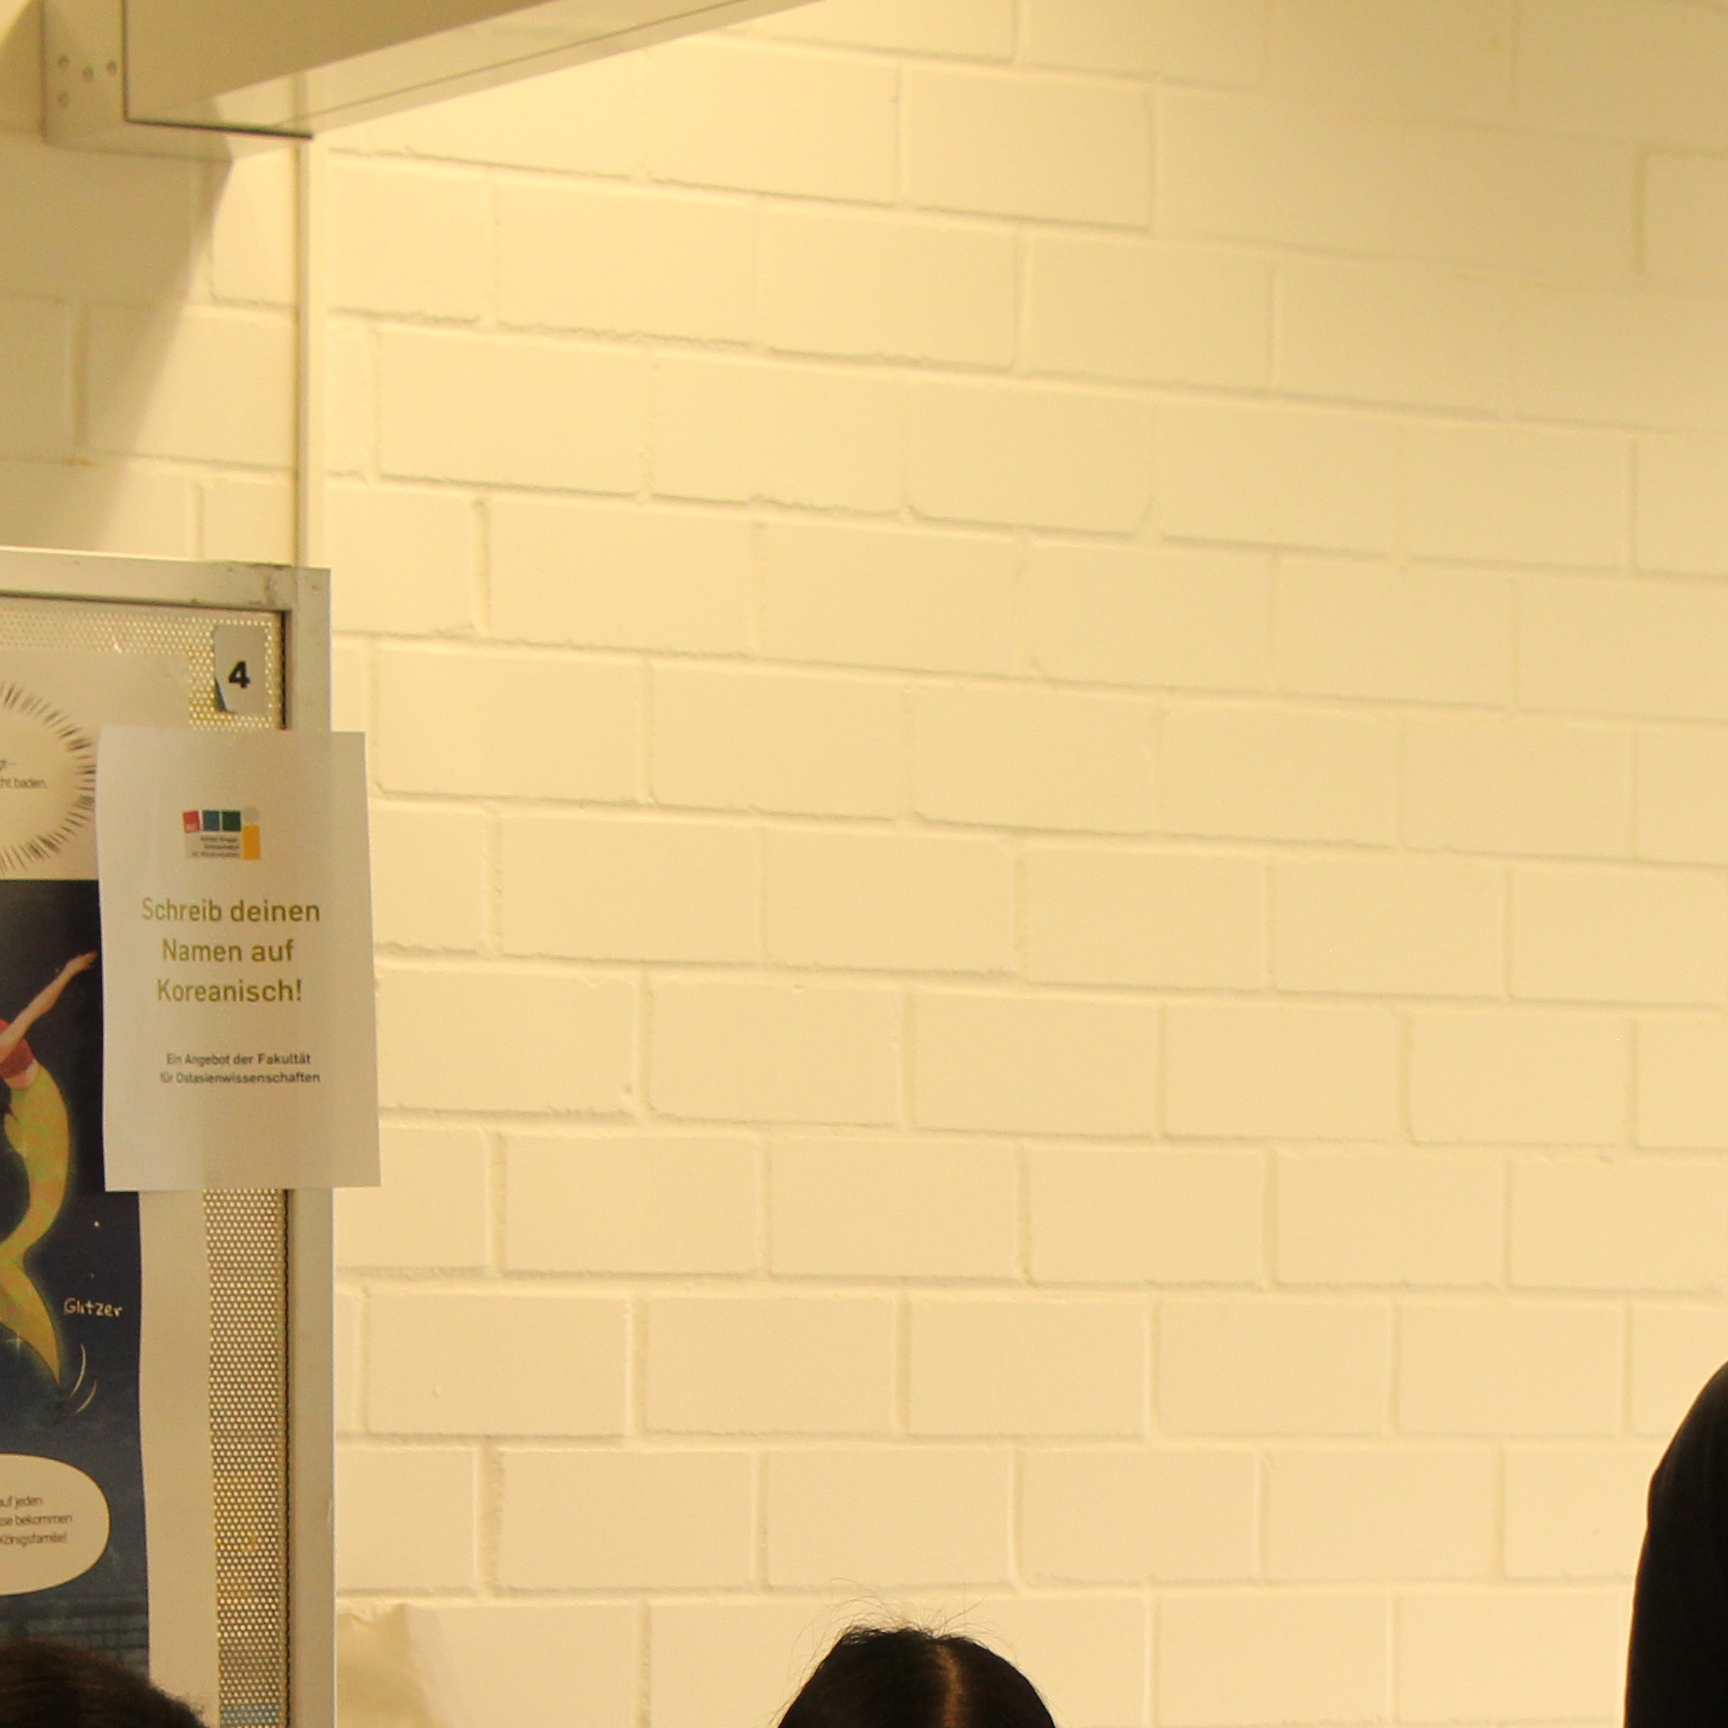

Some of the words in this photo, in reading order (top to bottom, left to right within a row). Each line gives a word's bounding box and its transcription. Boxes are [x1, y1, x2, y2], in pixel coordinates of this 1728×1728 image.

[229, 661, 251, 689] 4
[142, 897, 222, 922] Schreib
[230, 899, 320, 922] deinen
[162, 938, 242, 962] Namen
[251, 938, 294, 963] auf
[157, 978, 303, 1002] Koreanisch!
[167, 1053, 182, 1065] Ein
[185, 1053, 230, 1067] Angebot
[233, 1053, 253, 1065] der
[258, 1052, 311, 1065] Fakultät
[176, 1070, 321, 1084] Ostasienwissenschaften
[64, 1298, 122, 1319] Glitzer
[15, 1514, 72, 1526] bekommen
